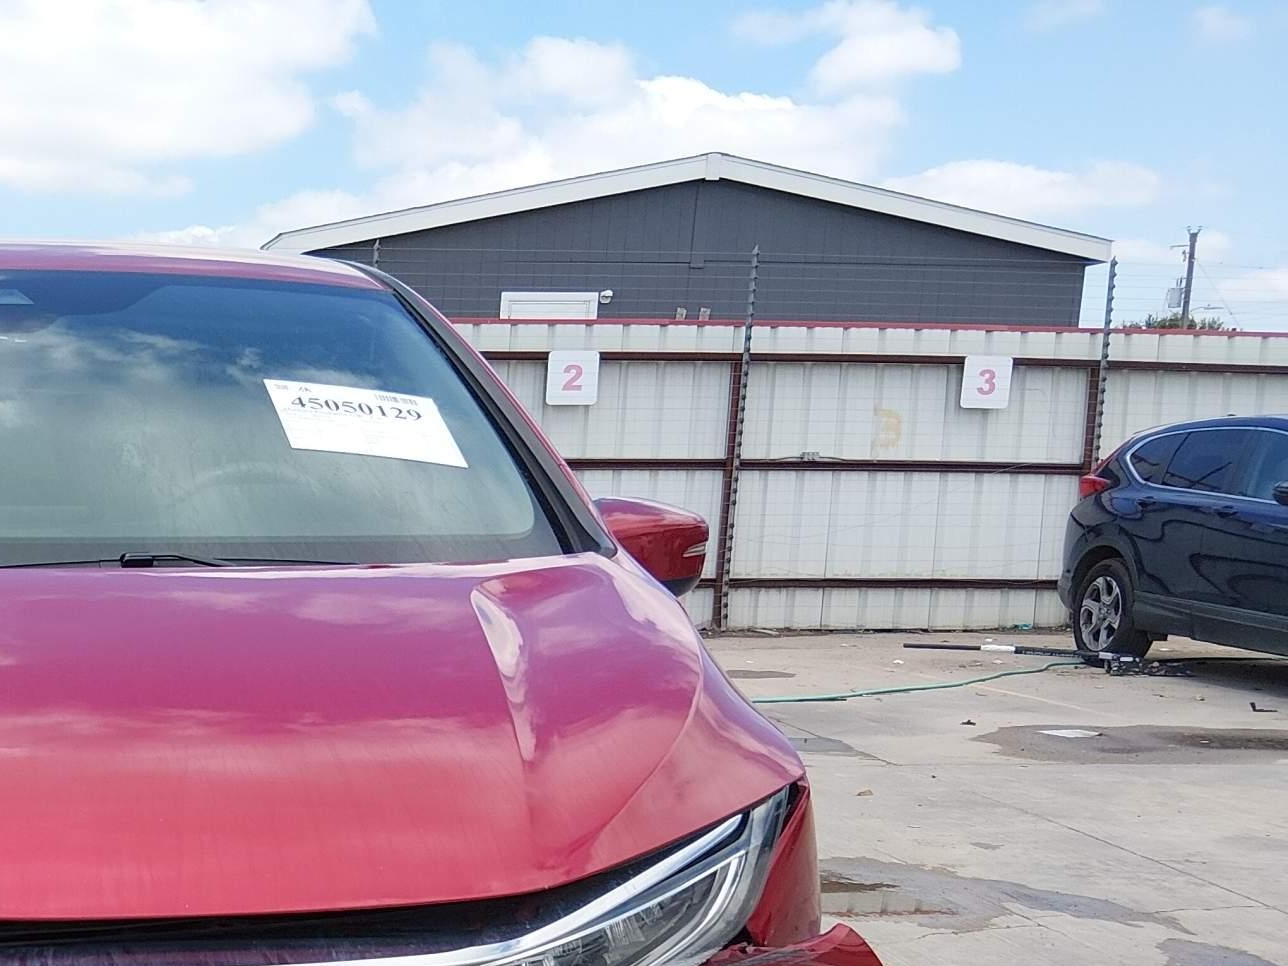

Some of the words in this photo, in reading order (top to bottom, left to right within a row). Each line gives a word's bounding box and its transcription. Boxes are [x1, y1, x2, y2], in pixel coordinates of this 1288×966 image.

[561, 364, 583, 391] 2
[976, 368, 996, 395] 3
[291, 396, 423, 421] 45050129
